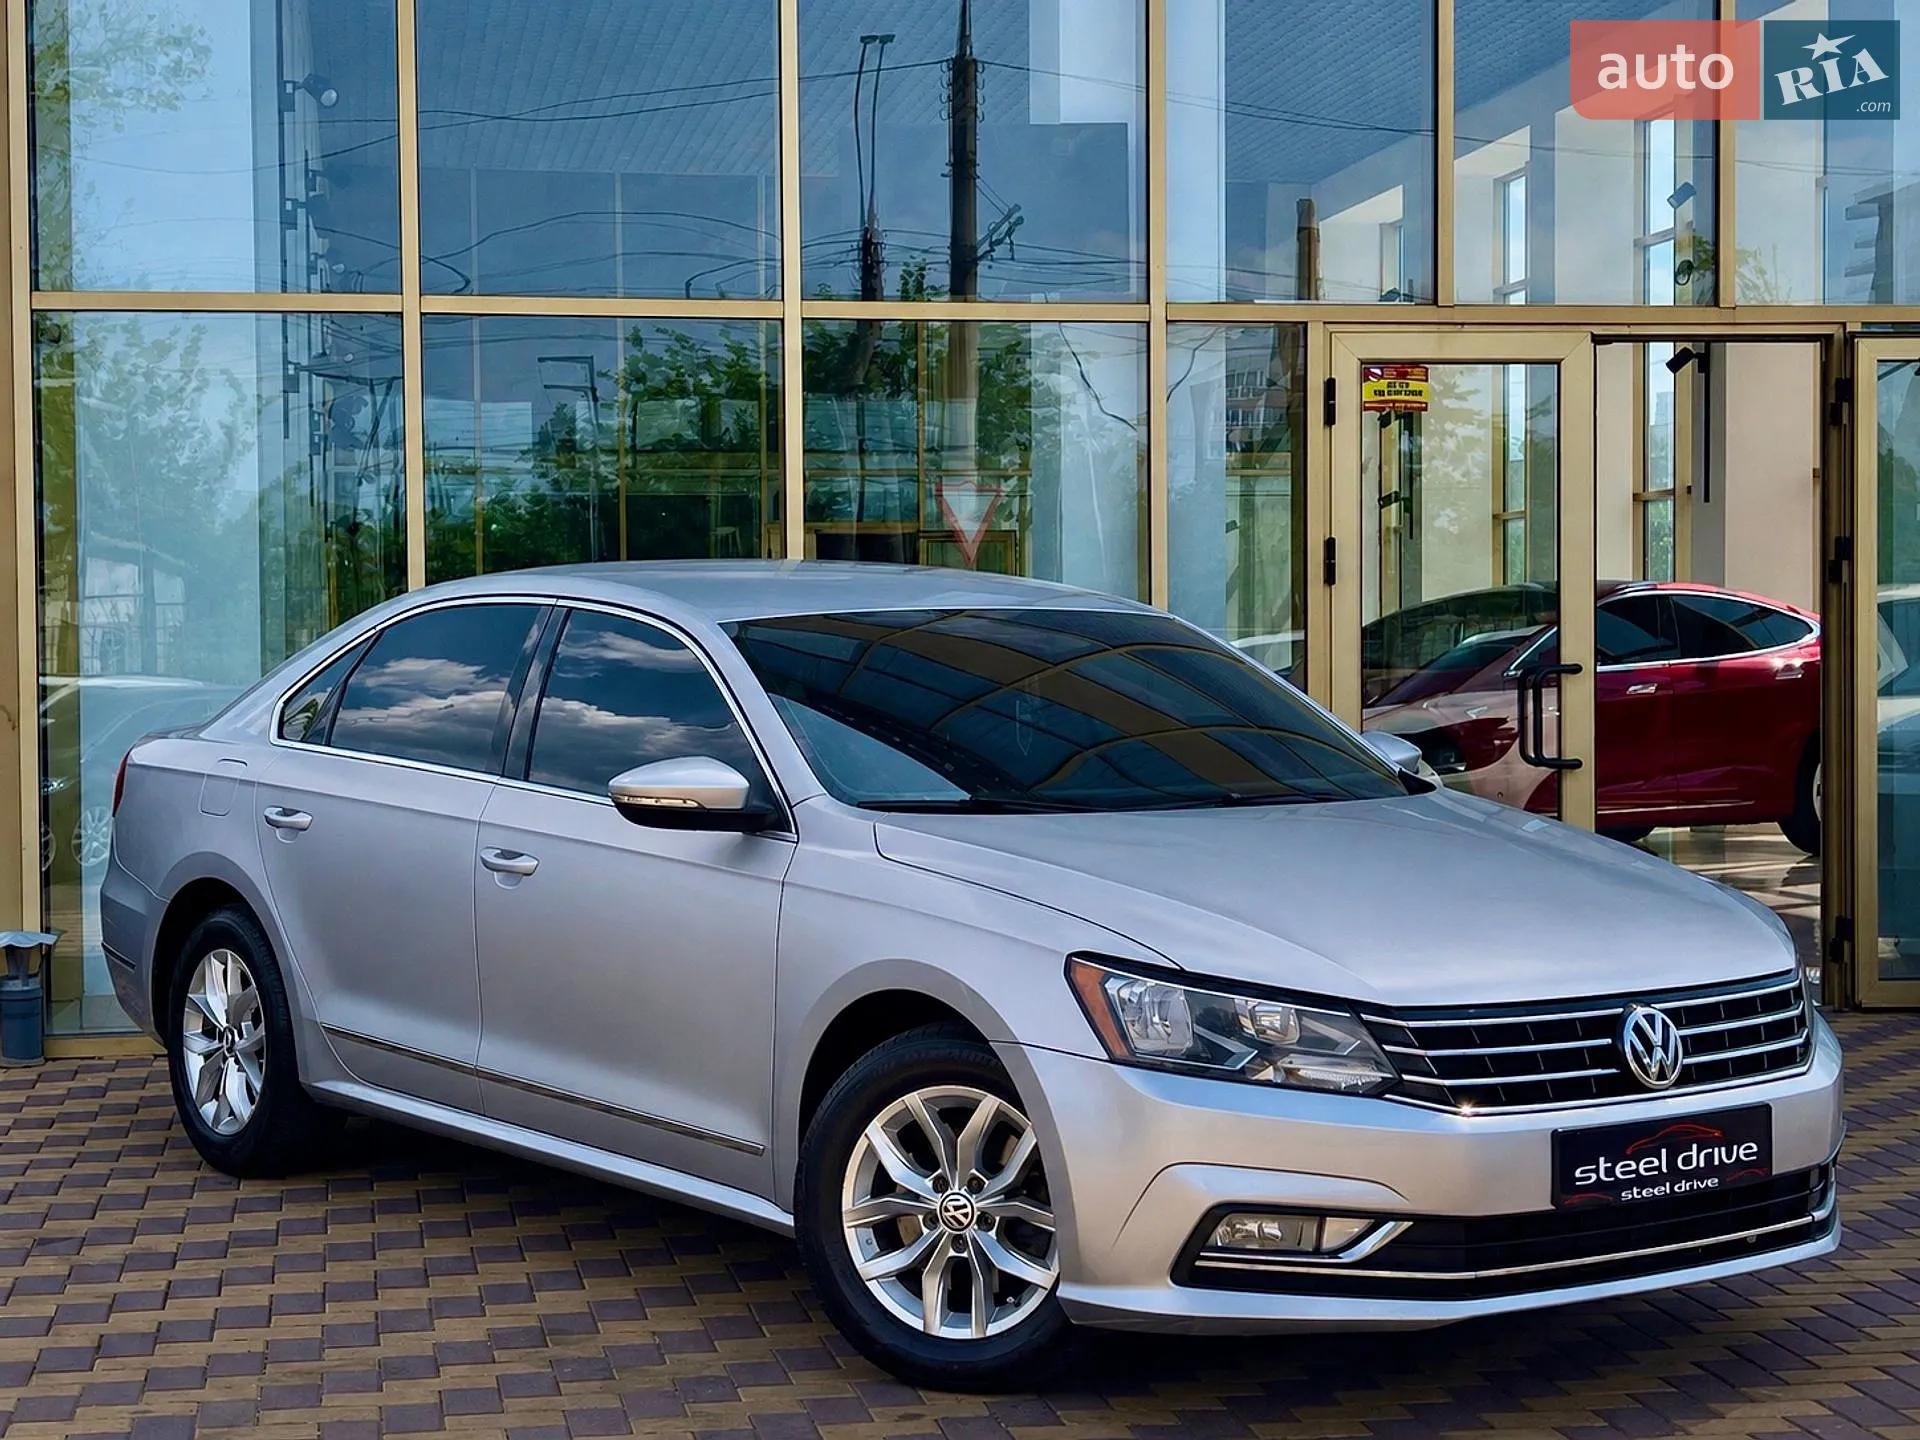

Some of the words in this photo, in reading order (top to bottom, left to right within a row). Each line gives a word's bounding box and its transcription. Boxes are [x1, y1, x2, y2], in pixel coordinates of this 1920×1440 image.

[1575, 1148, 1668, 1186] steel
[1677, 1142, 1758, 1171] drive
[1621, 1182, 1670, 1201] steel
[1674, 1176, 1719, 1193] drive
